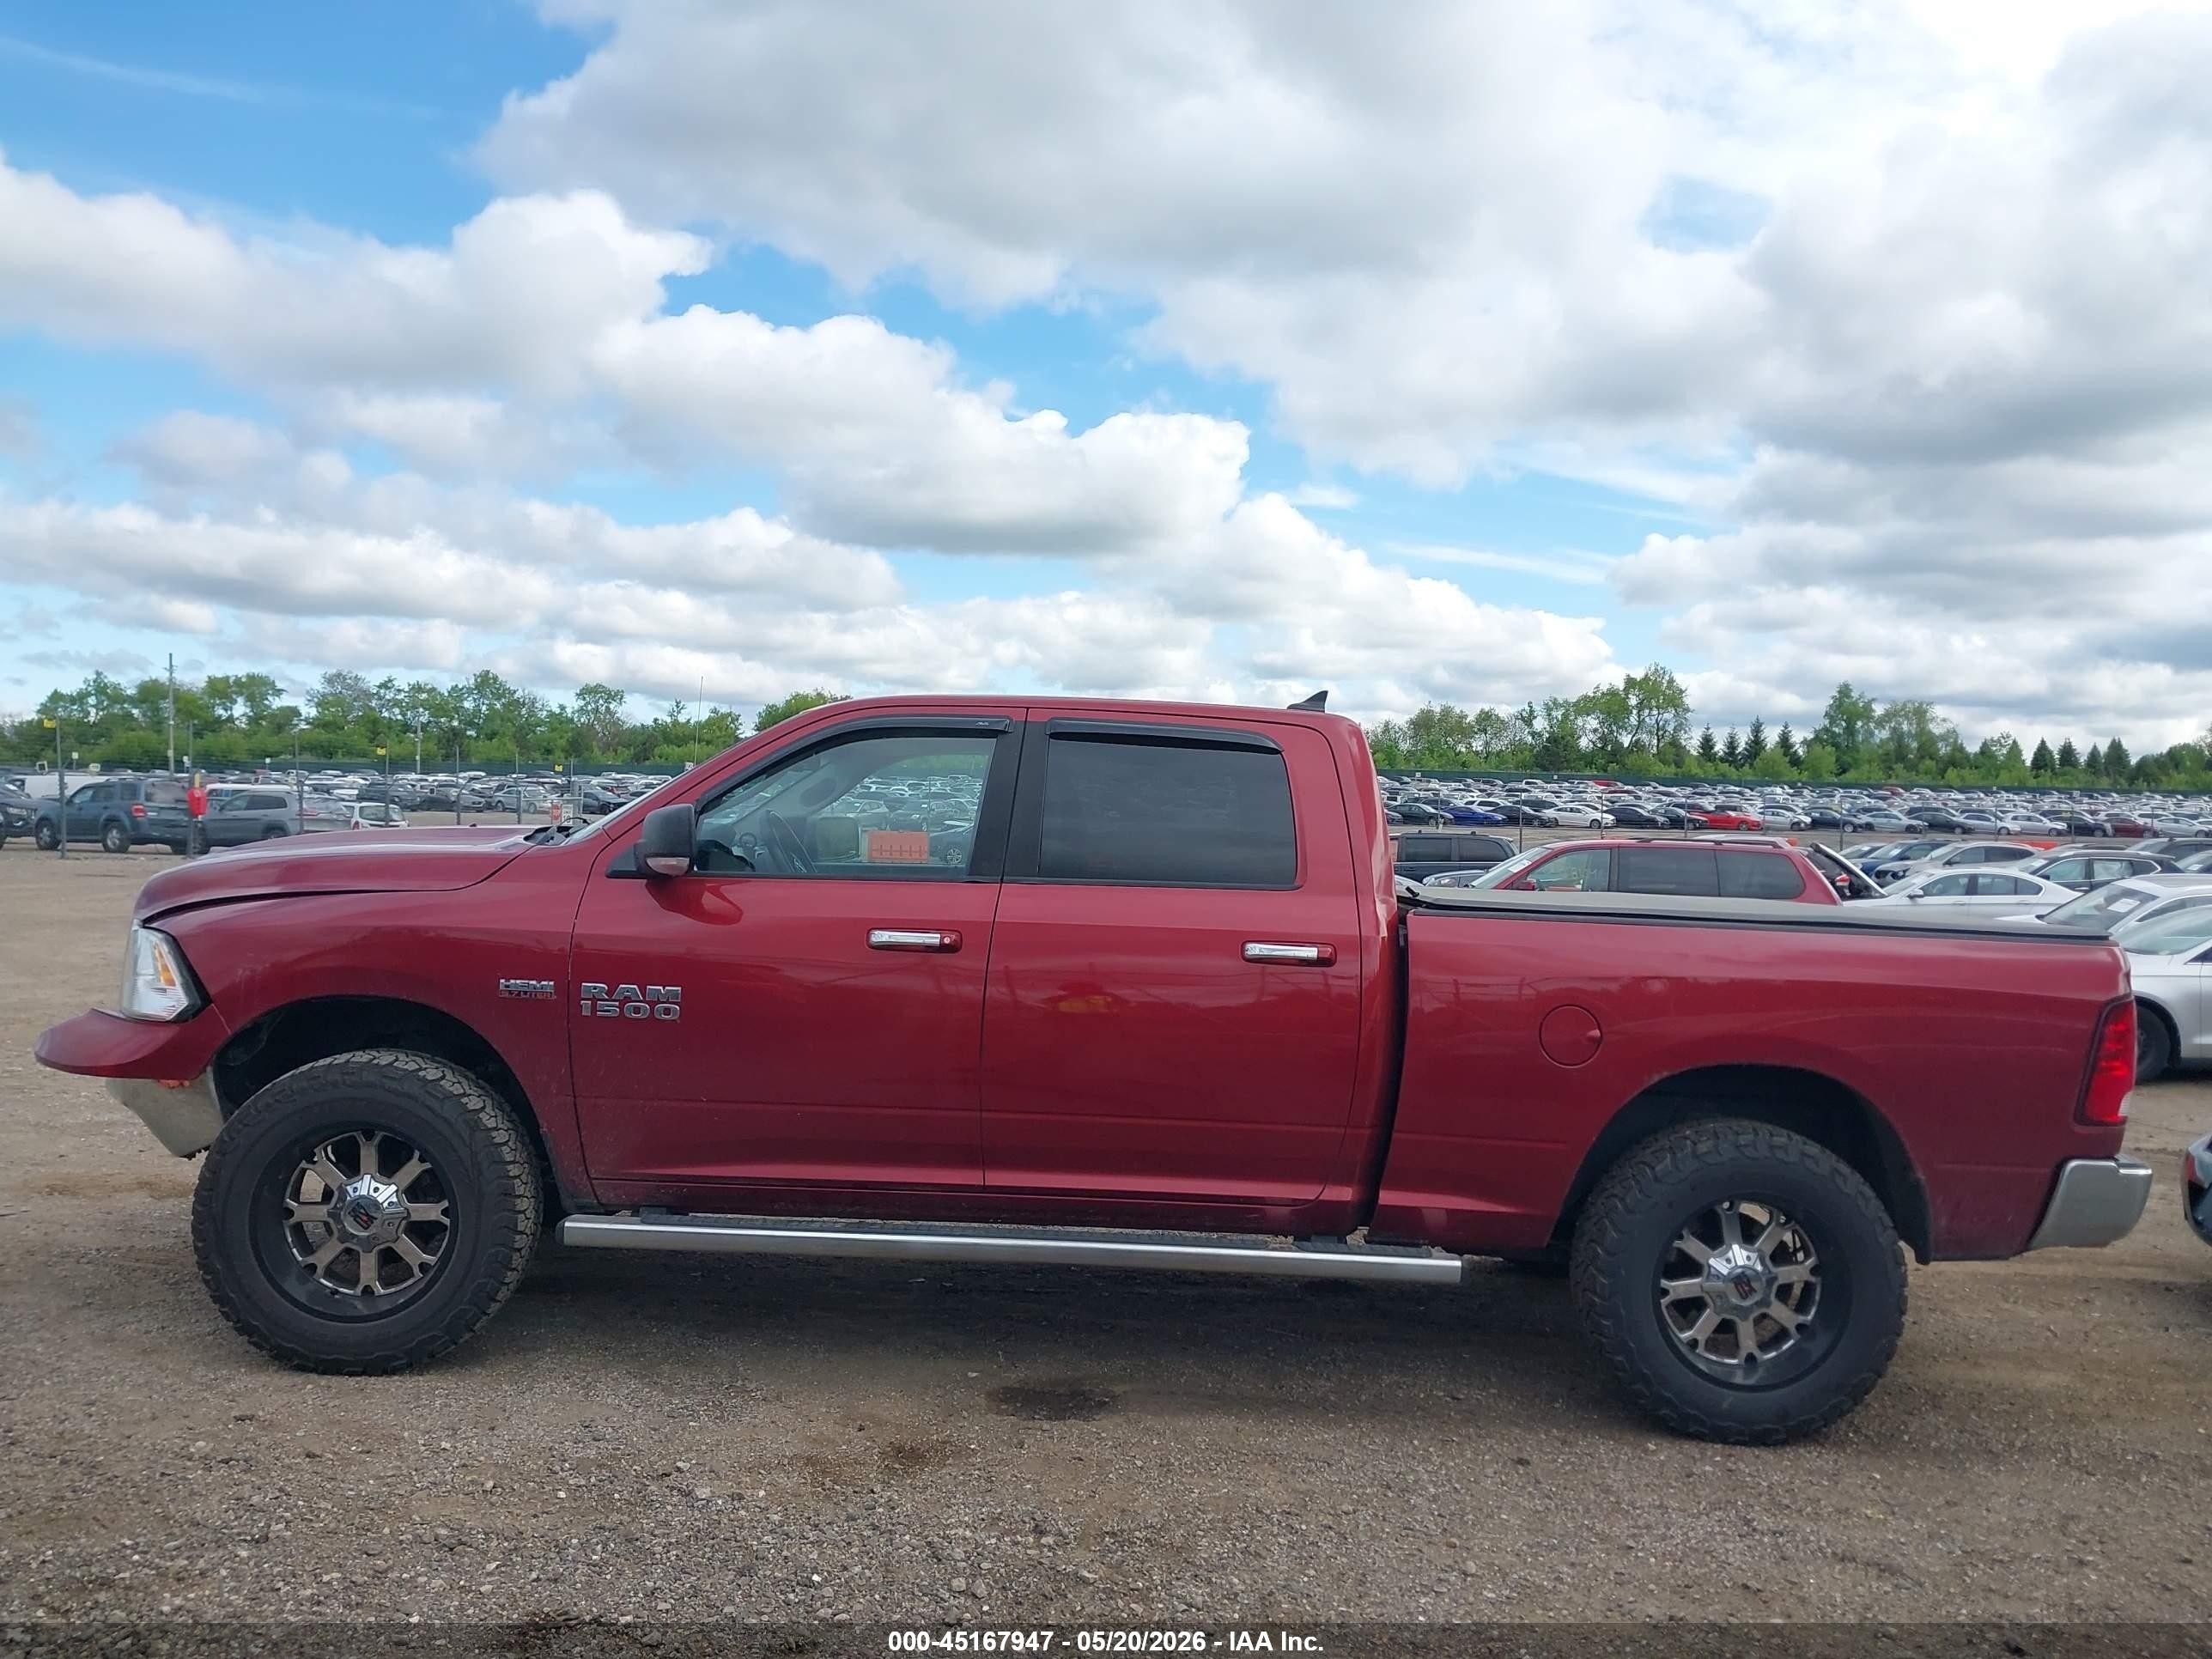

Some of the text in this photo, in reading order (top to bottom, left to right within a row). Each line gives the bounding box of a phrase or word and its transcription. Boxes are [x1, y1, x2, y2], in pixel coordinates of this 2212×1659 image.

[499, 979, 555, 991] HEMI
[580, 982, 682, 1002] RAM
[580, 1000, 681, 1021] 1500
